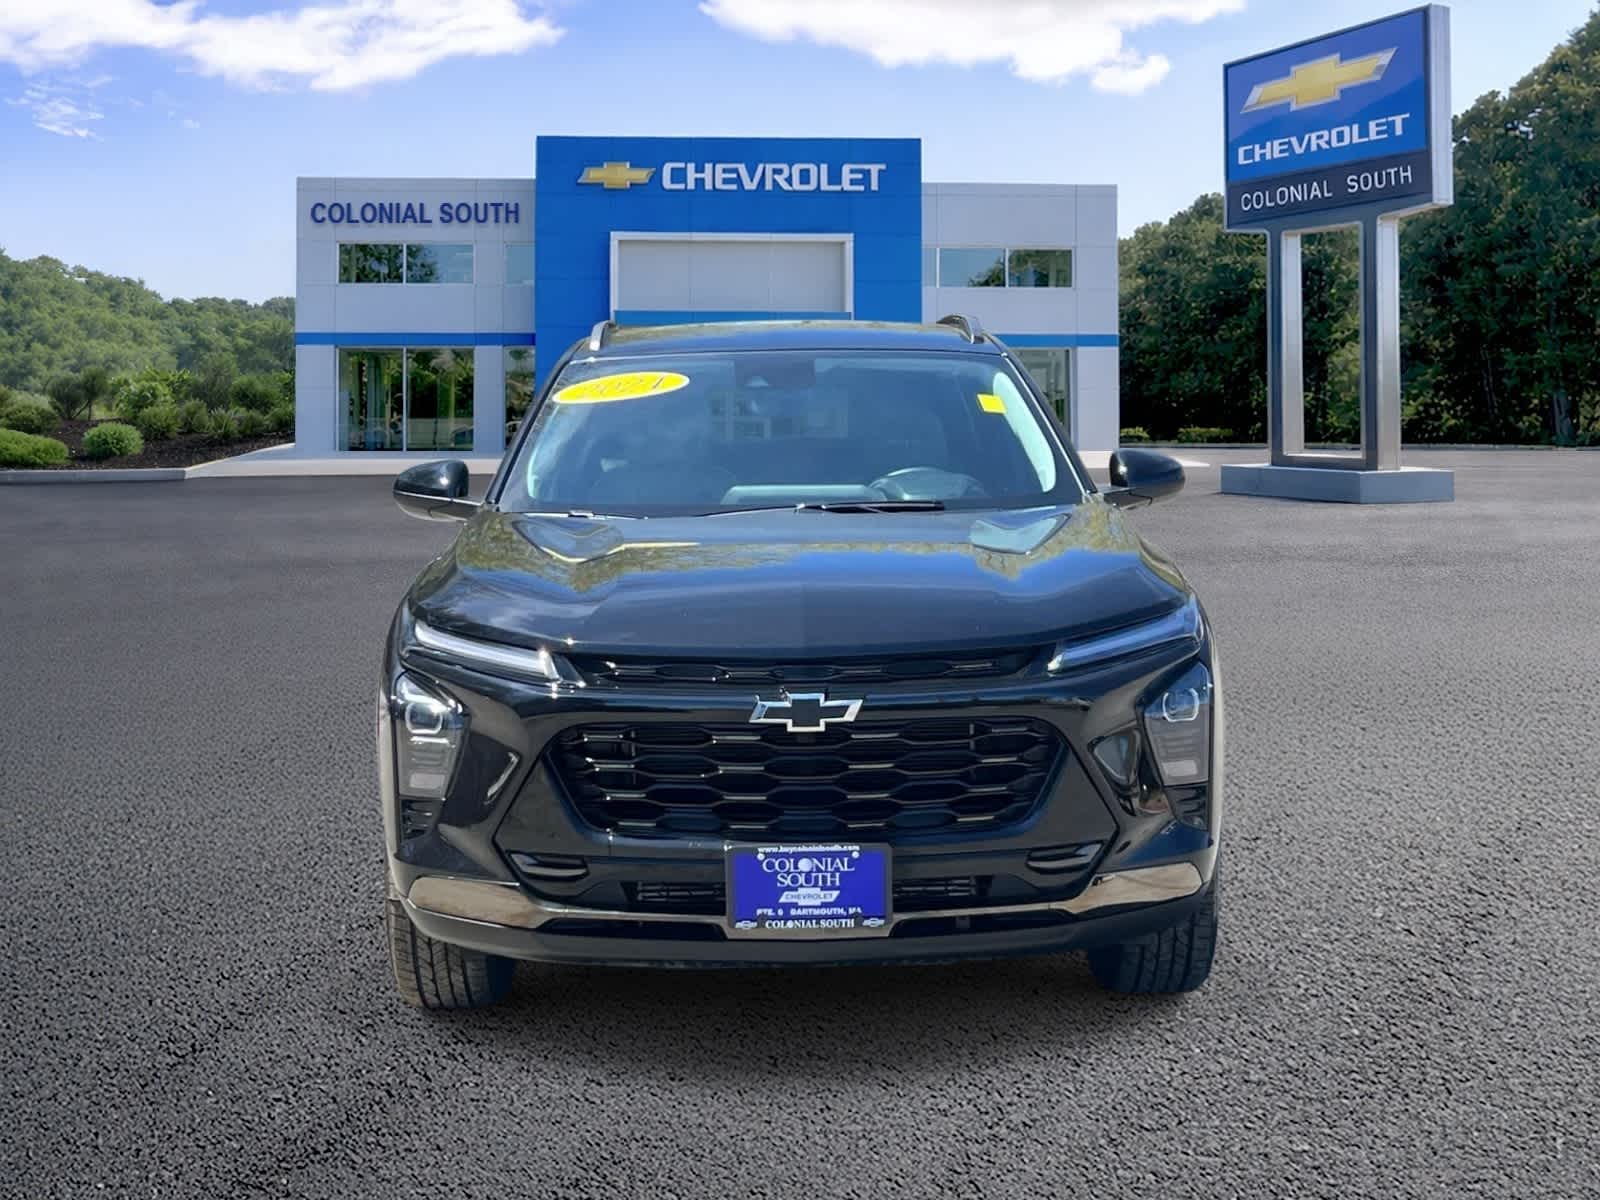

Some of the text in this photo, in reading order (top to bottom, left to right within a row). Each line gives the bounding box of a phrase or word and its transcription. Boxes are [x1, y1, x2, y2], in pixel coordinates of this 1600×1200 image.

[1237, 113, 1410, 165] CHEVROLET
[662, 162, 887, 192] CHEVROLET
[1241, 165, 1413, 211] COLONIAL SOUTH
[310, 202, 520, 225] COLONIAL SOUTH
[762, 858, 855, 872] COLONIAL
[777, 873, 840, 887] SOUTH
[765, 919, 855, 929] COLONIAL SOUTH
